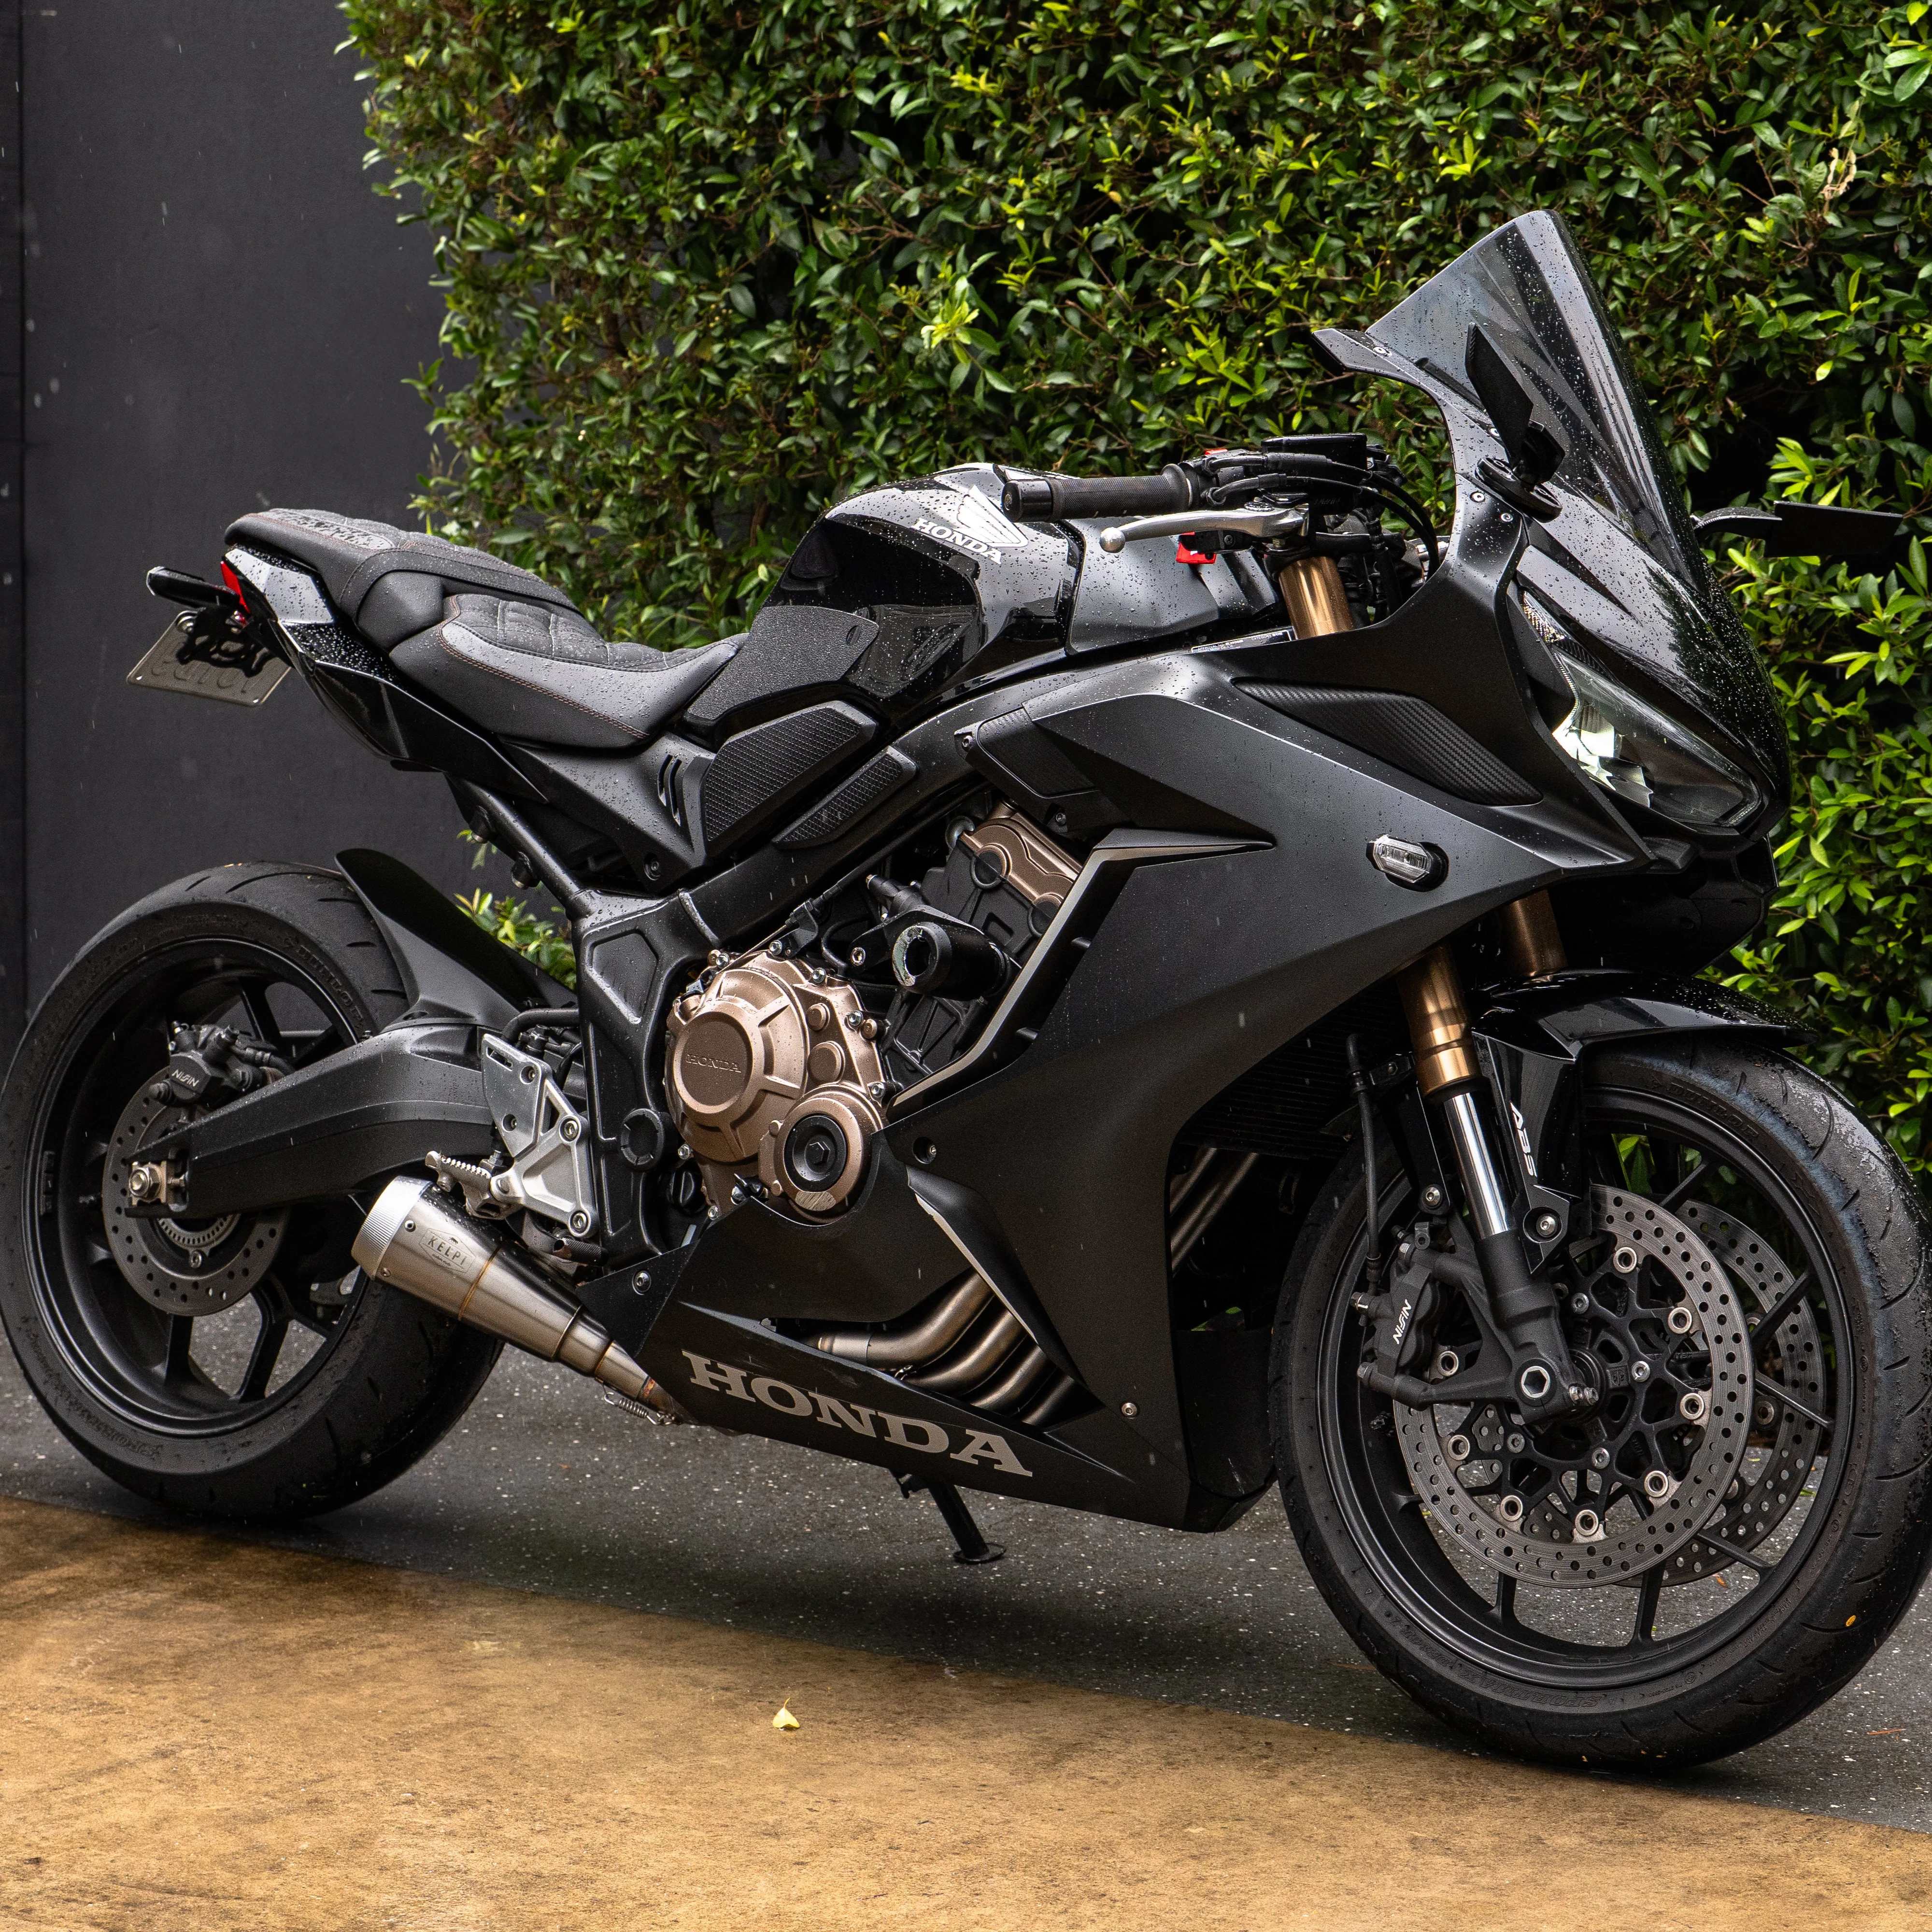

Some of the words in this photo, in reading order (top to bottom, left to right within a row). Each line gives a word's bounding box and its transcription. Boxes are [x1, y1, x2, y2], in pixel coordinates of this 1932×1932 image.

[910, 517, 1003, 565] HONDA
[172, 1069, 199, 1087] NISSIN
[686, 1054, 741, 1073] HONDA
[1667, 1082, 1759, 1137] DUNLOP
[1509, 1101, 1537, 1177] ABS
[427, 1236, 468, 1265] KELPI
[1392, 1299, 1412, 1345] NISSIN
[682, 1349, 1033, 1477] HONDA
[1458, 1668, 1602, 1707] SPORTMAX
